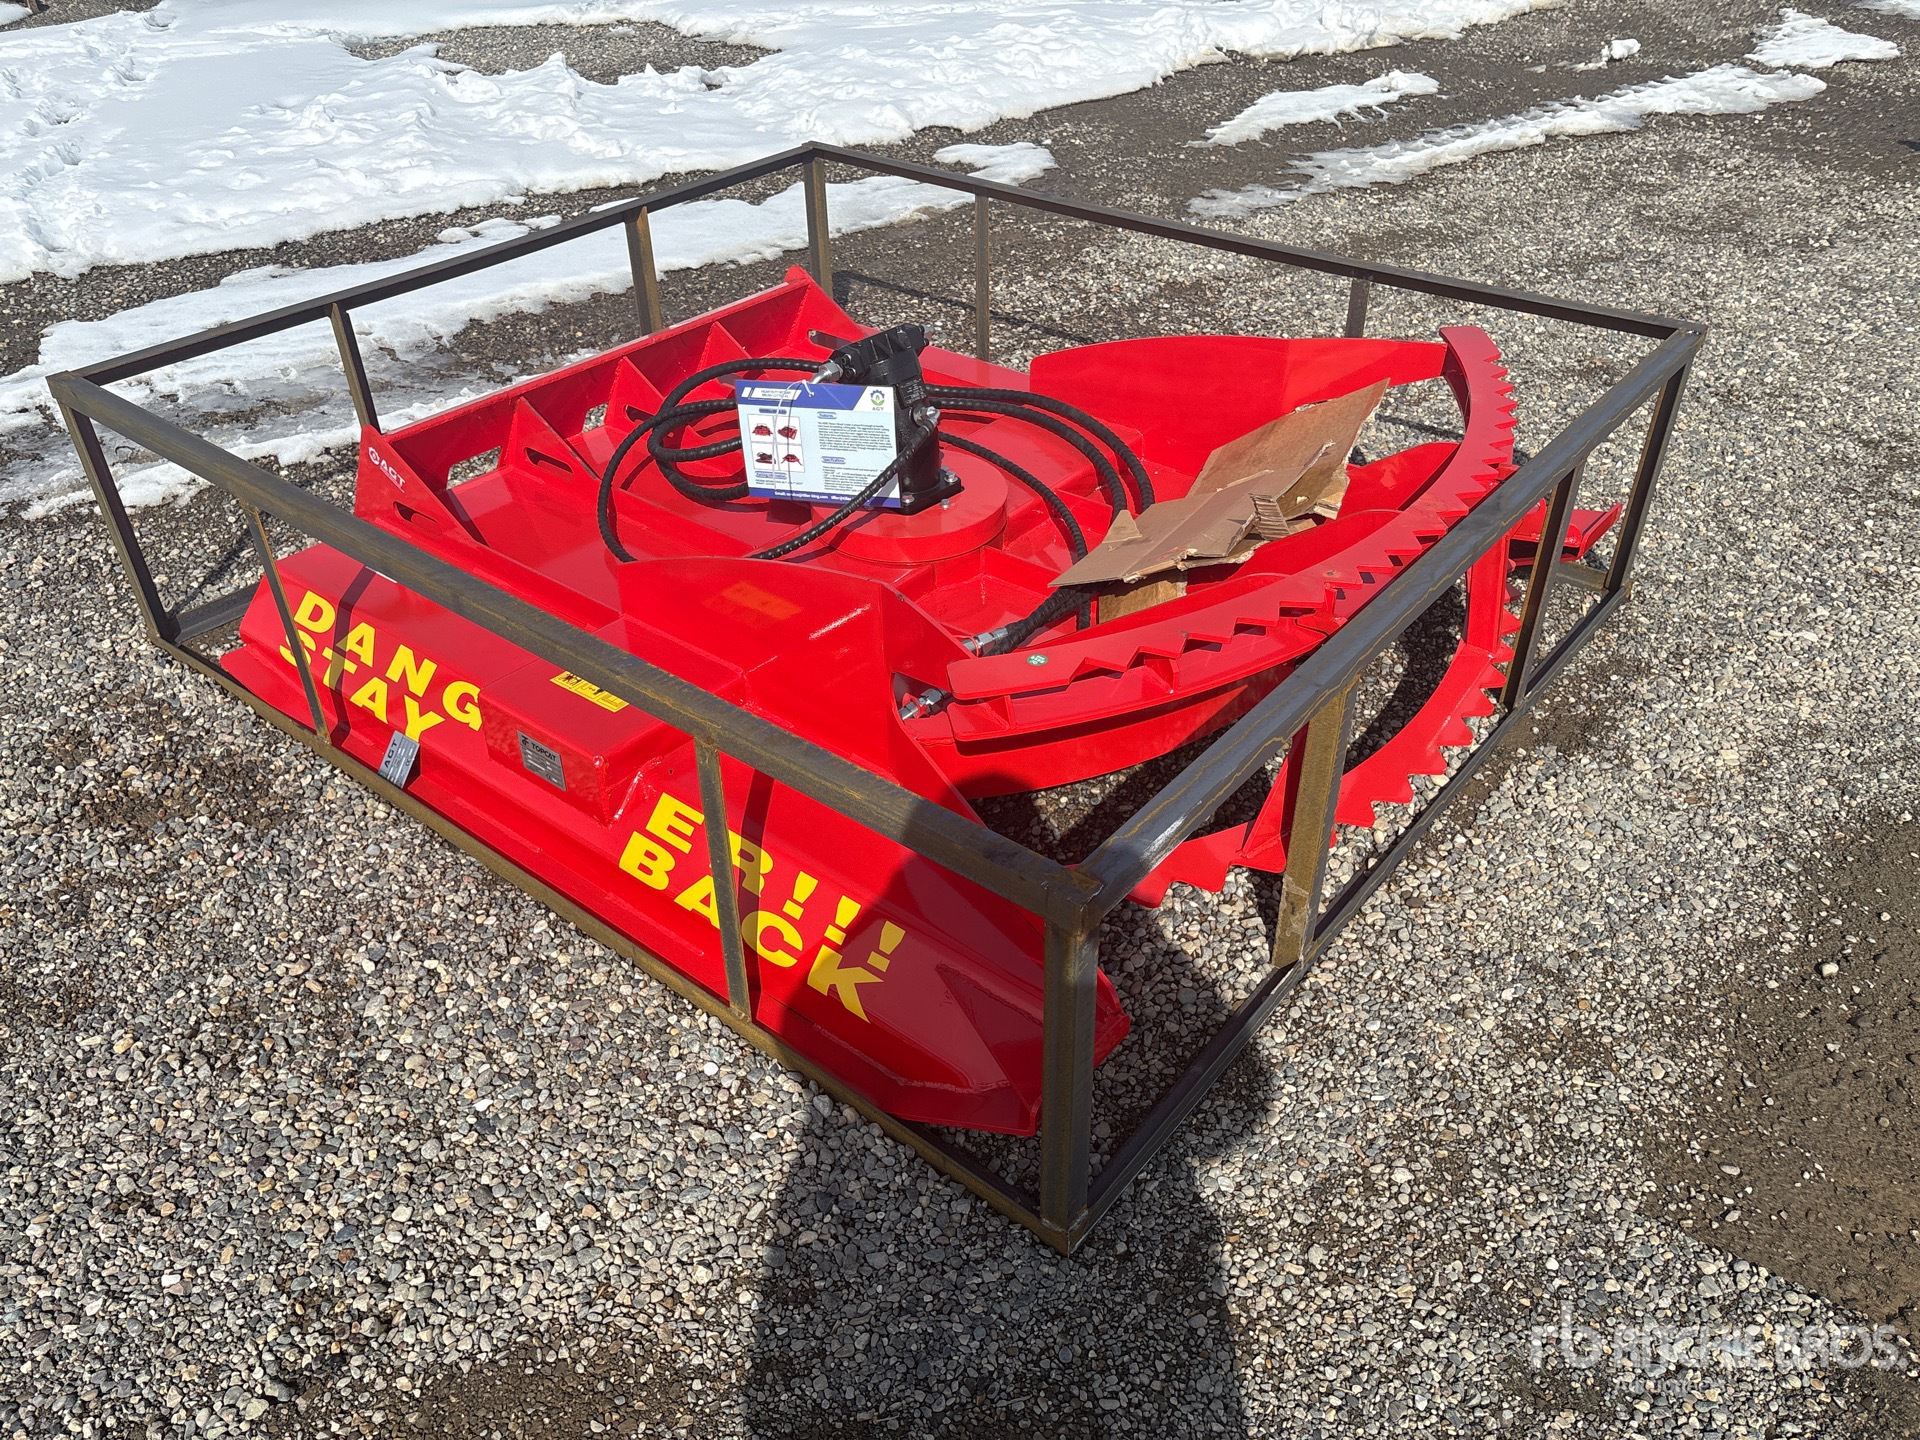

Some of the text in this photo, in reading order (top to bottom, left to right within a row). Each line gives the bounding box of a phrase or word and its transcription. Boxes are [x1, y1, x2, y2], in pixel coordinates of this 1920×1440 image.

[380, 459, 406, 488] AGT
[293, 590, 483, 732] DANG
[279, 629, 885, 1024] STAY BACK
